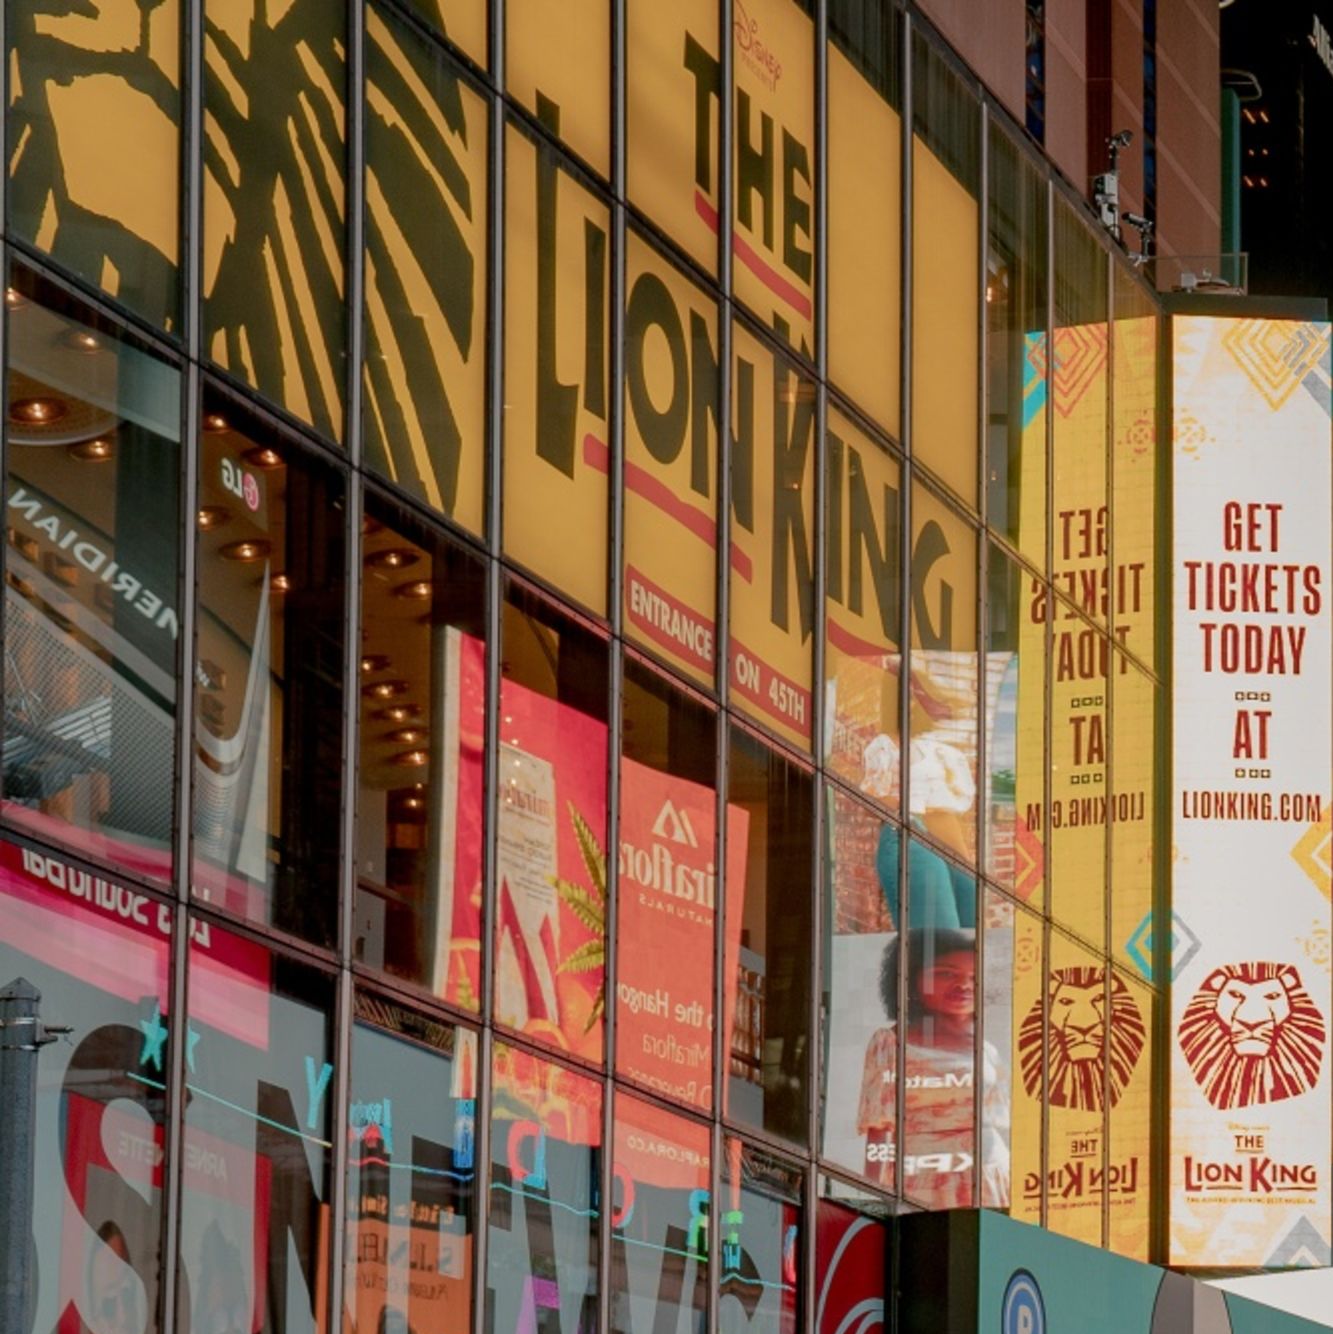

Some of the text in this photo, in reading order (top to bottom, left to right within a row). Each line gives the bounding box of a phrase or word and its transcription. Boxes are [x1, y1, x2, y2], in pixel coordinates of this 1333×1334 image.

[683, 29, 812, 287] THE
[535, 90, 954, 655] LION KING
[1222, 501, 1284, 553] GET
[1184, 561, 1322, 617] TICKETS
[630, 580, 714, 658] ENTRANCE
[1199, 623, 1307, 676] TODAY
[735, 654, 806, 726] ON 45TH
[1232, 710, 1273, 761] AT
[1182, 790, 1322, 824] LIONKING.COM
[1234, 1134, 1265, 1149] THE
[1184, 1156, 1317, 1193] LION KING
